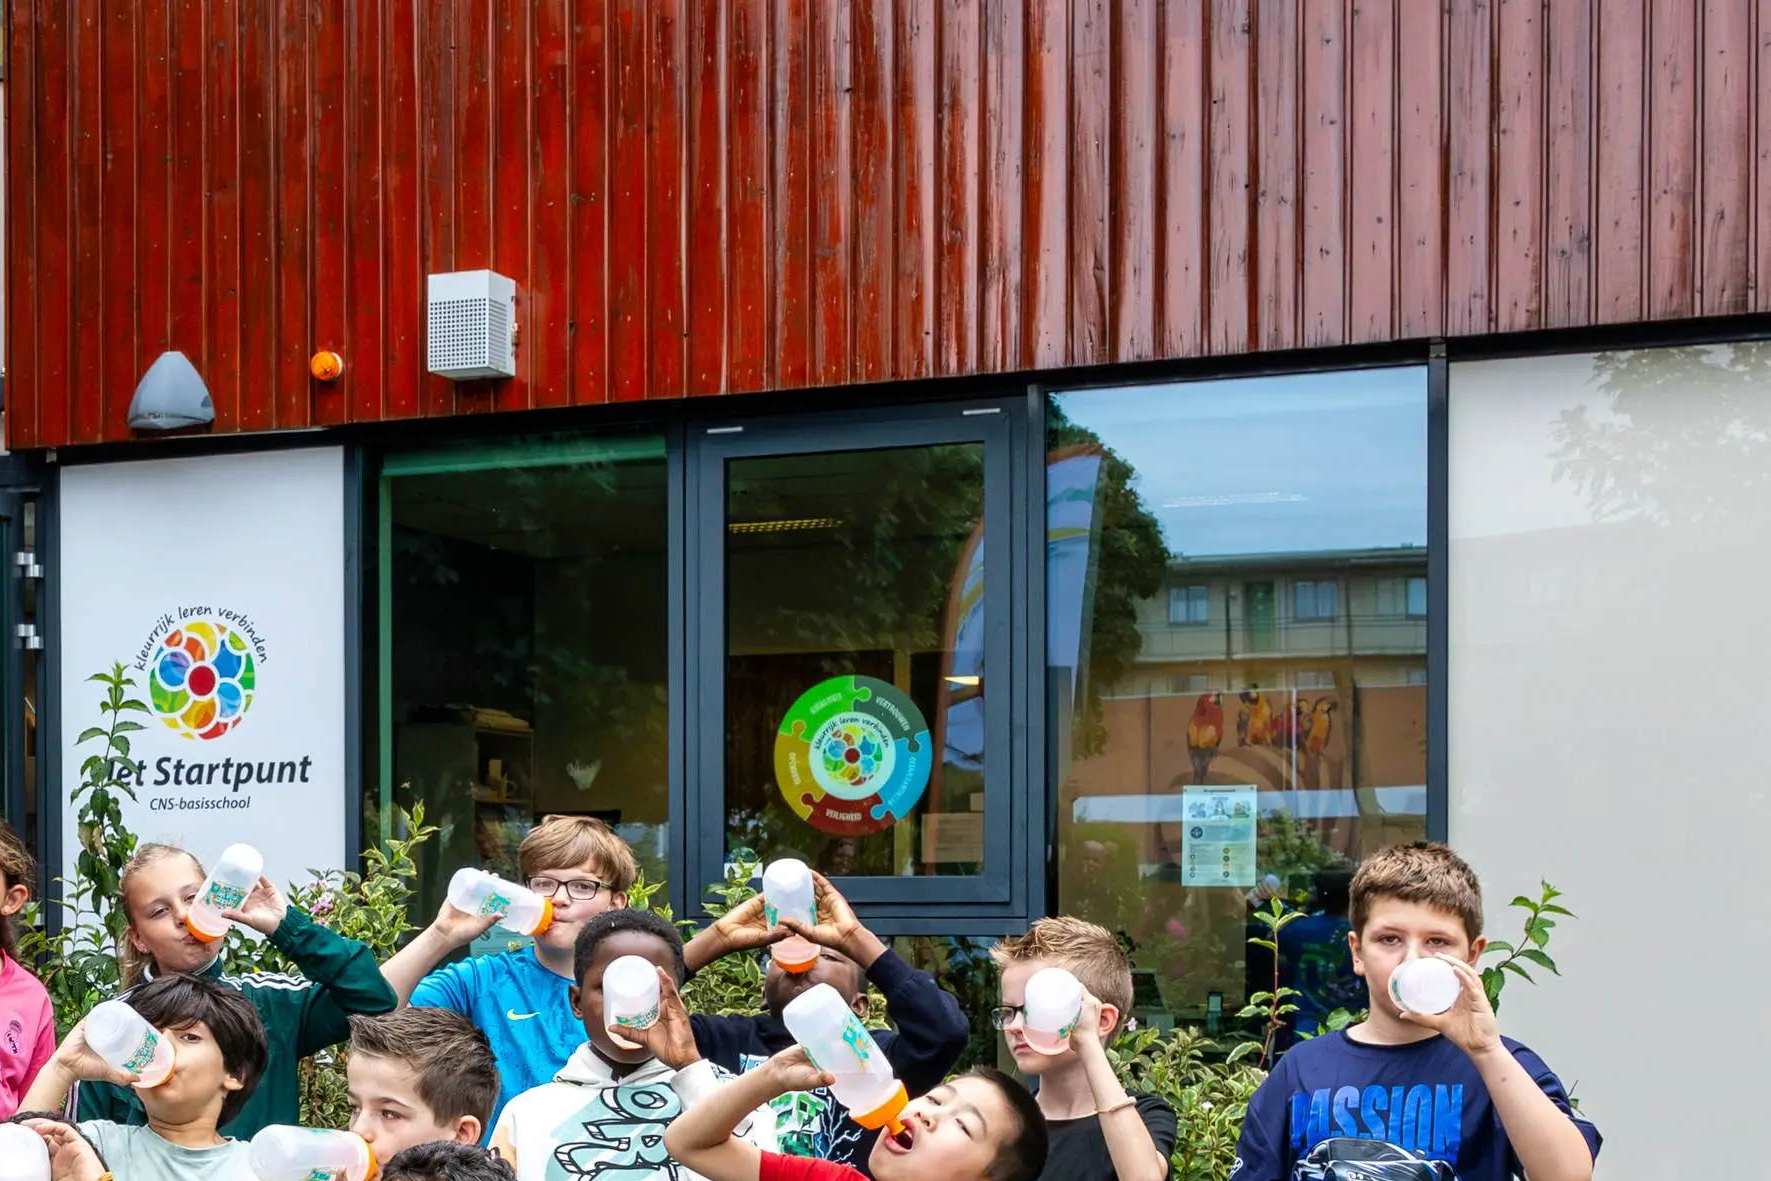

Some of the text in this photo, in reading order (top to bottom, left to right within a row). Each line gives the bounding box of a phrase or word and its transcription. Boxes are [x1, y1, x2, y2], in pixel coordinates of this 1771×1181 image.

[134, 605, 269, 672] kleurrijk leren verbinden
[153, 755, 312, 792] Startpunt
[150, 796, 251, 811] CNS-basisschool
[1290, 1083, 1464, 1152] PASSION
